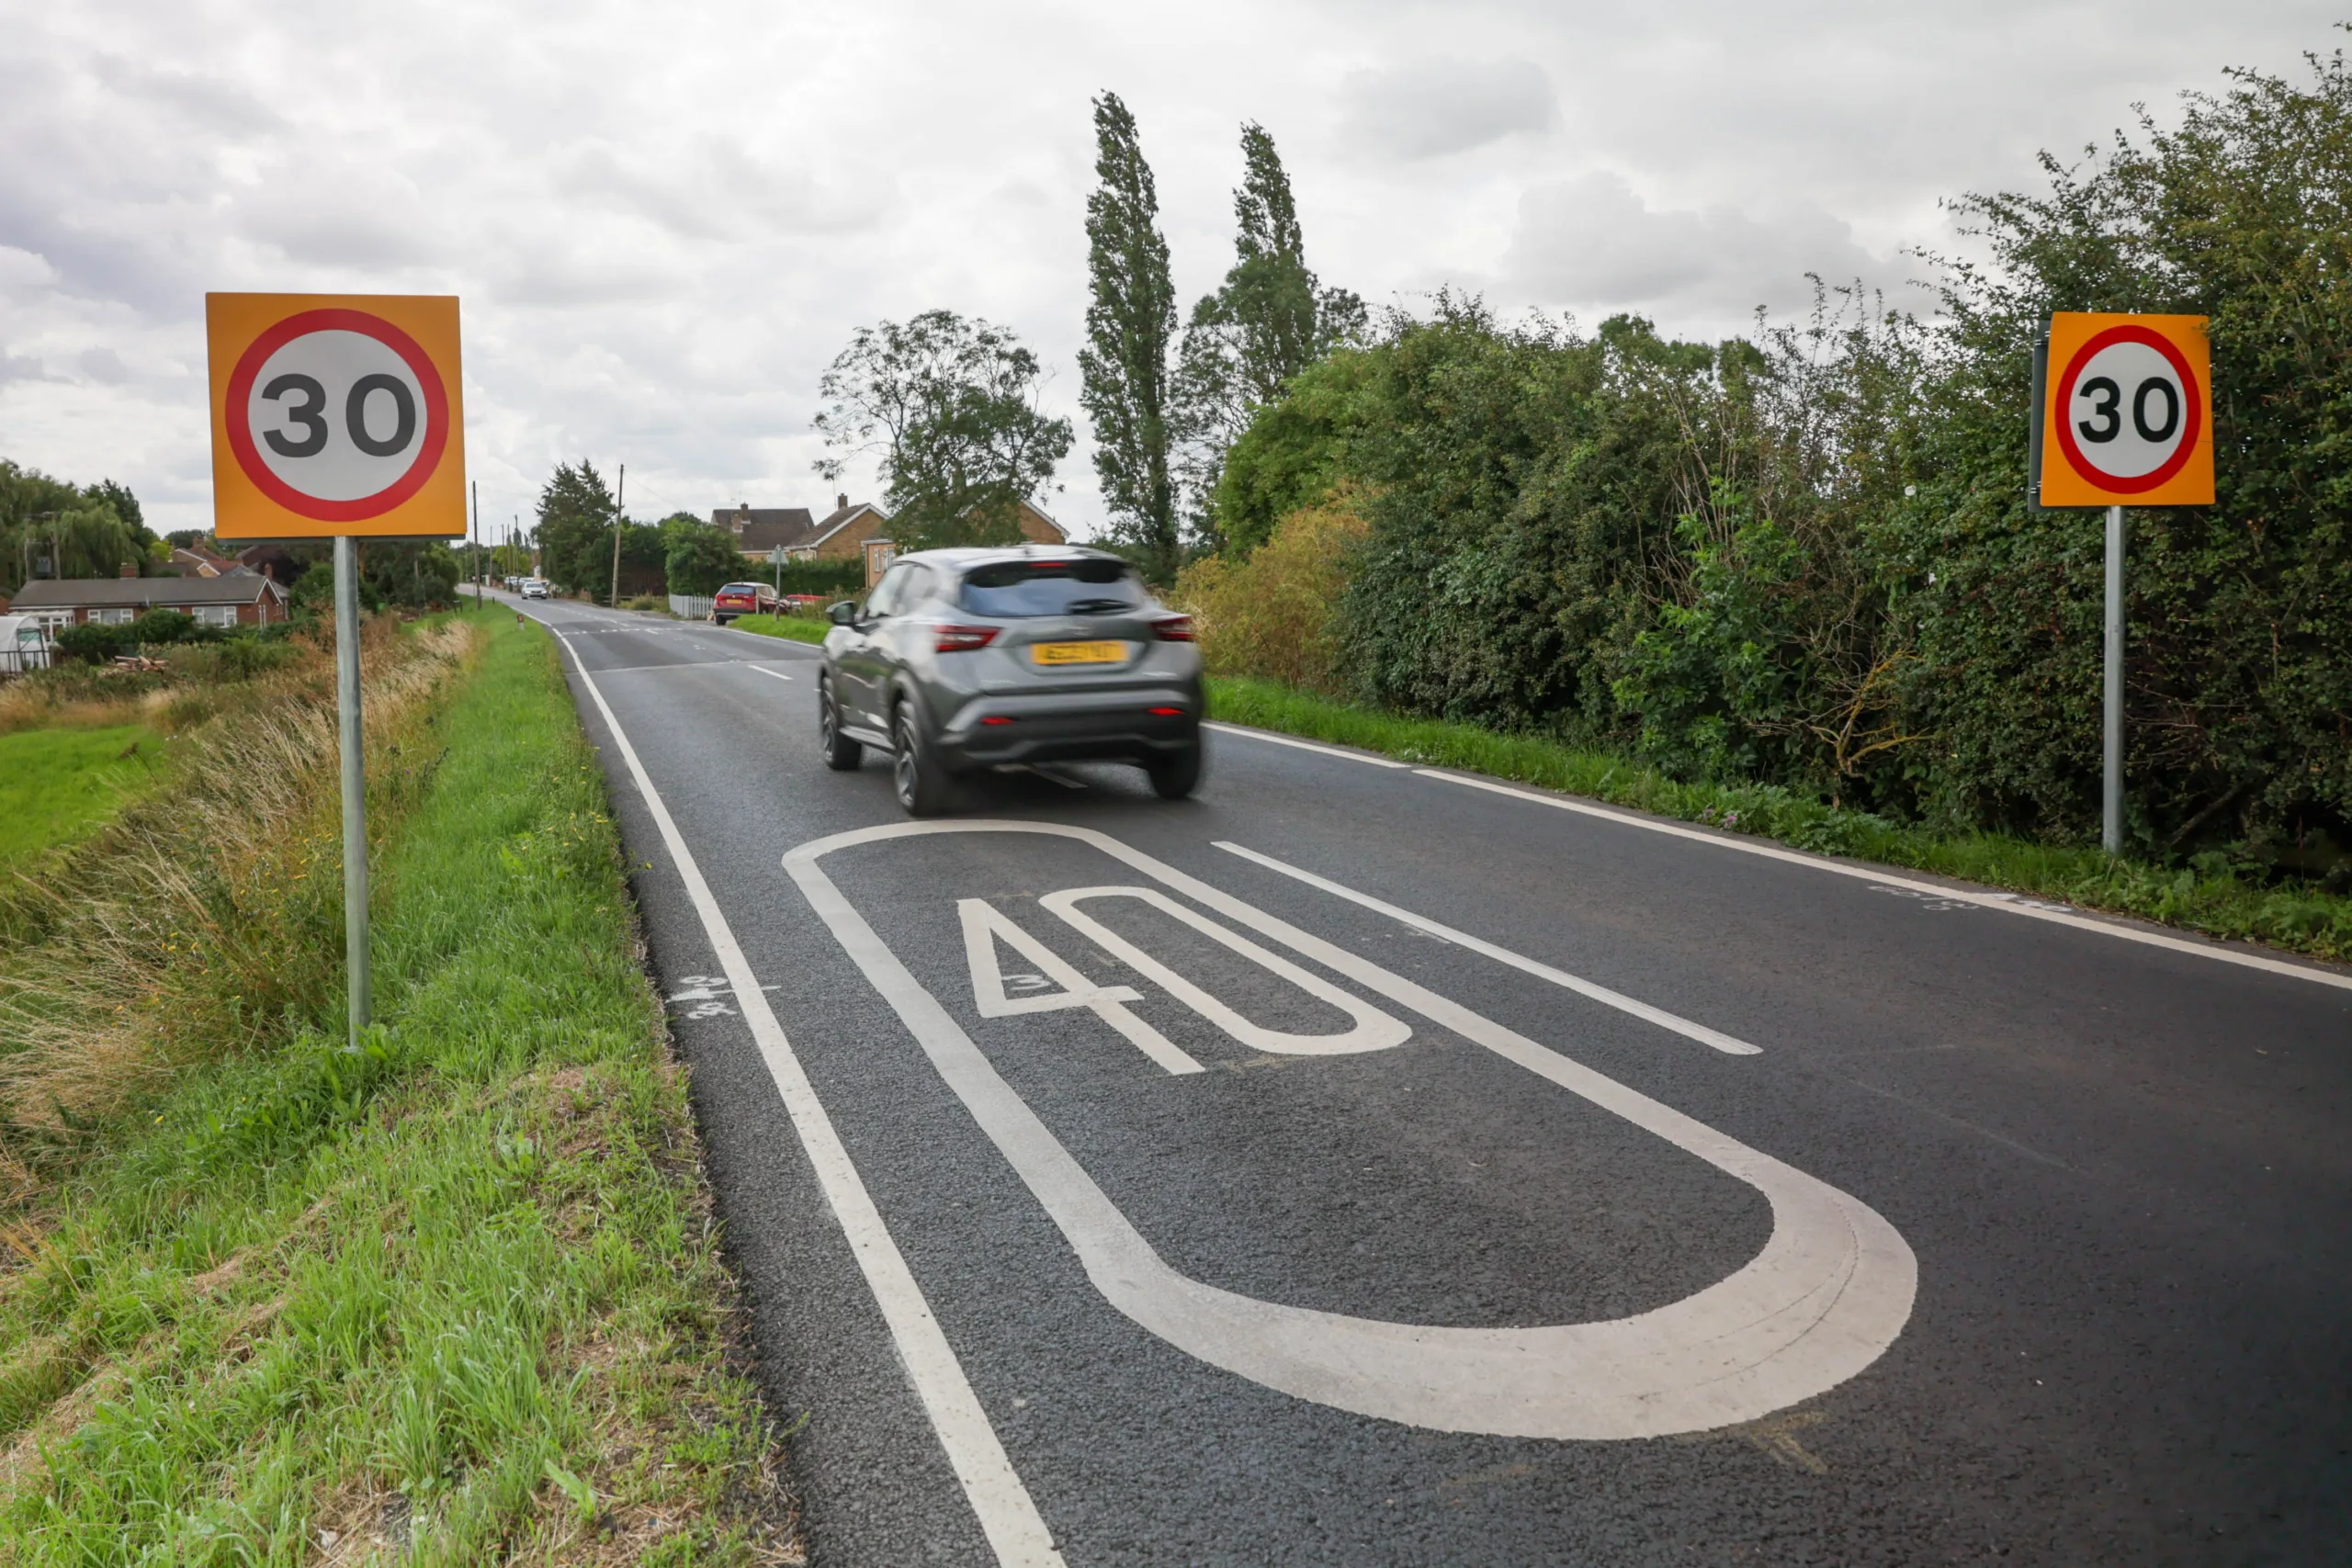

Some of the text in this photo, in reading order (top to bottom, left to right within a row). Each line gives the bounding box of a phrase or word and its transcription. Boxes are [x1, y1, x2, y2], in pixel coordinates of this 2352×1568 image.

[262, 373, 416, 457] 30
[2078, 376, 2179, 443] 30
[956, 885, 1413, 1077] 40
